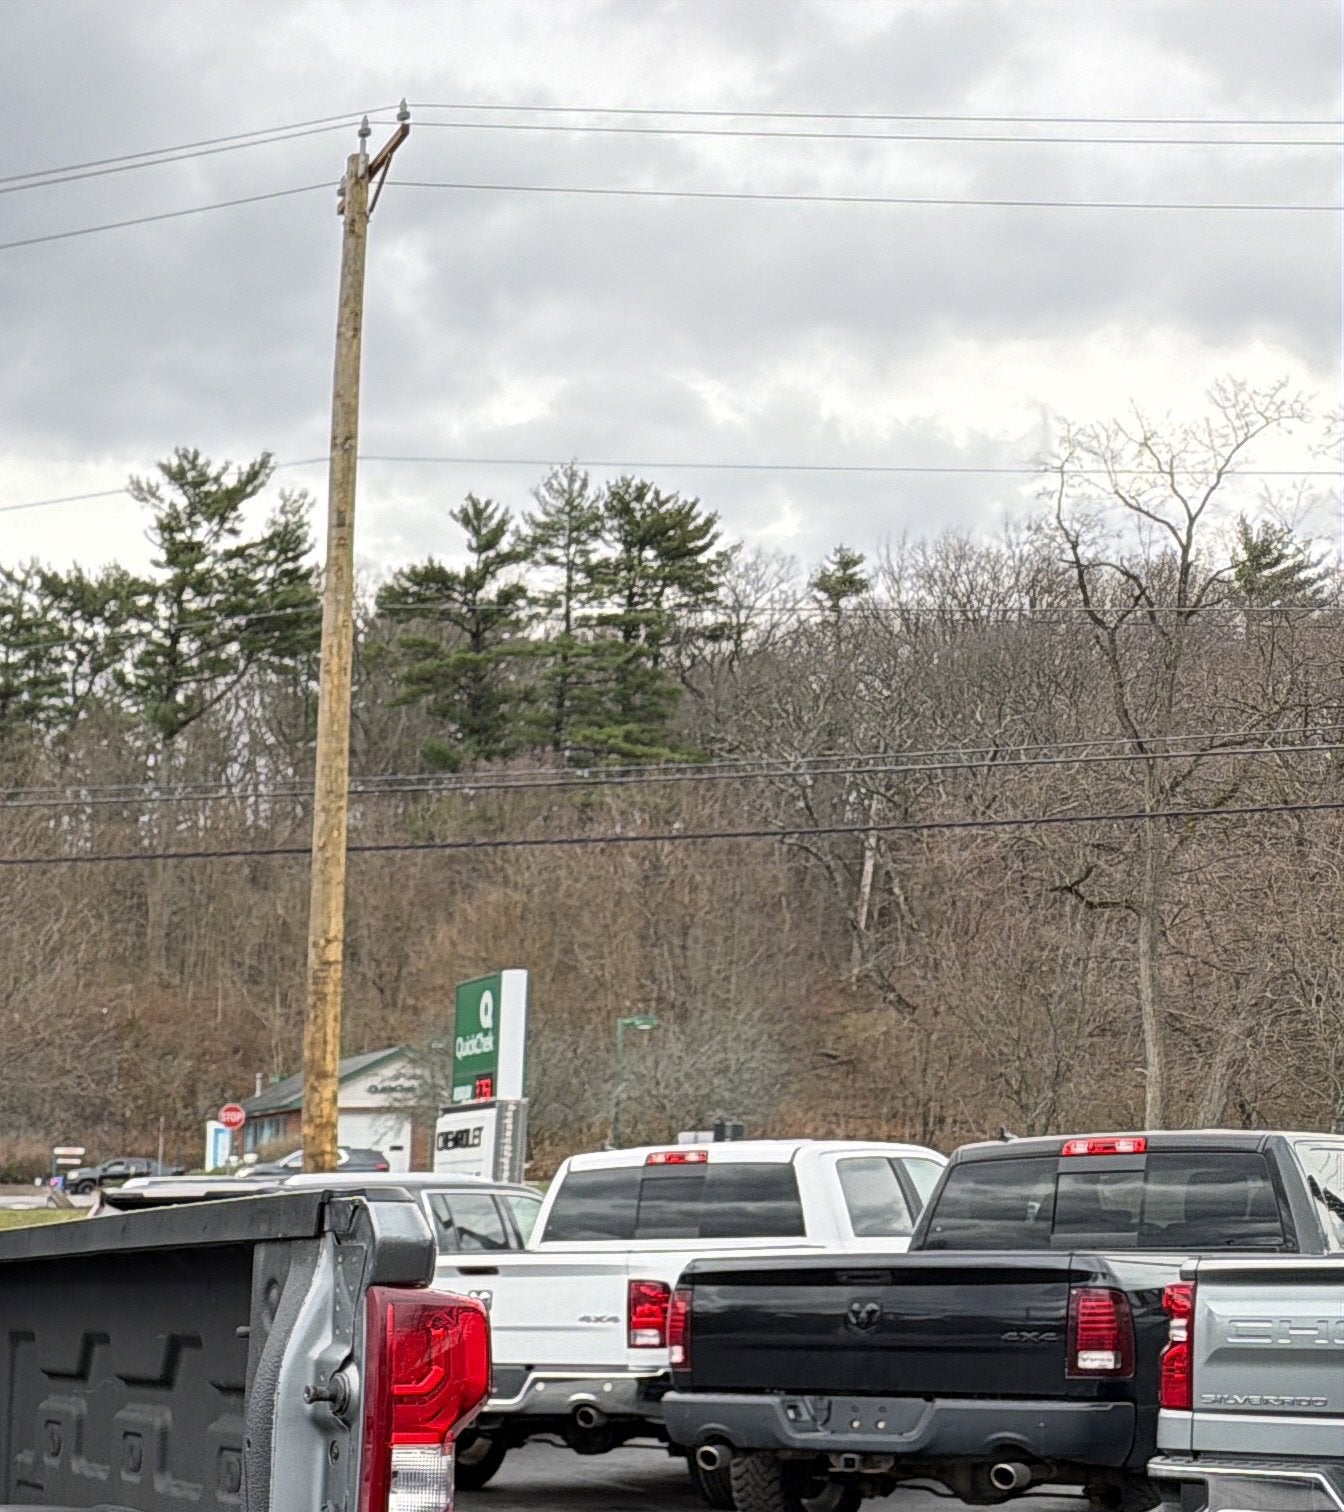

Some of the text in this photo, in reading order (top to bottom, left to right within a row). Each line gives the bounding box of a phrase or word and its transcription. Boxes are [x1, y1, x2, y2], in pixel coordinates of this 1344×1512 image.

[220, 1111, 242, 1123] STOP
[1227, 1320, 1344, 1343] CH
[1201, 1394, 1328, 1407] SILVERADO
